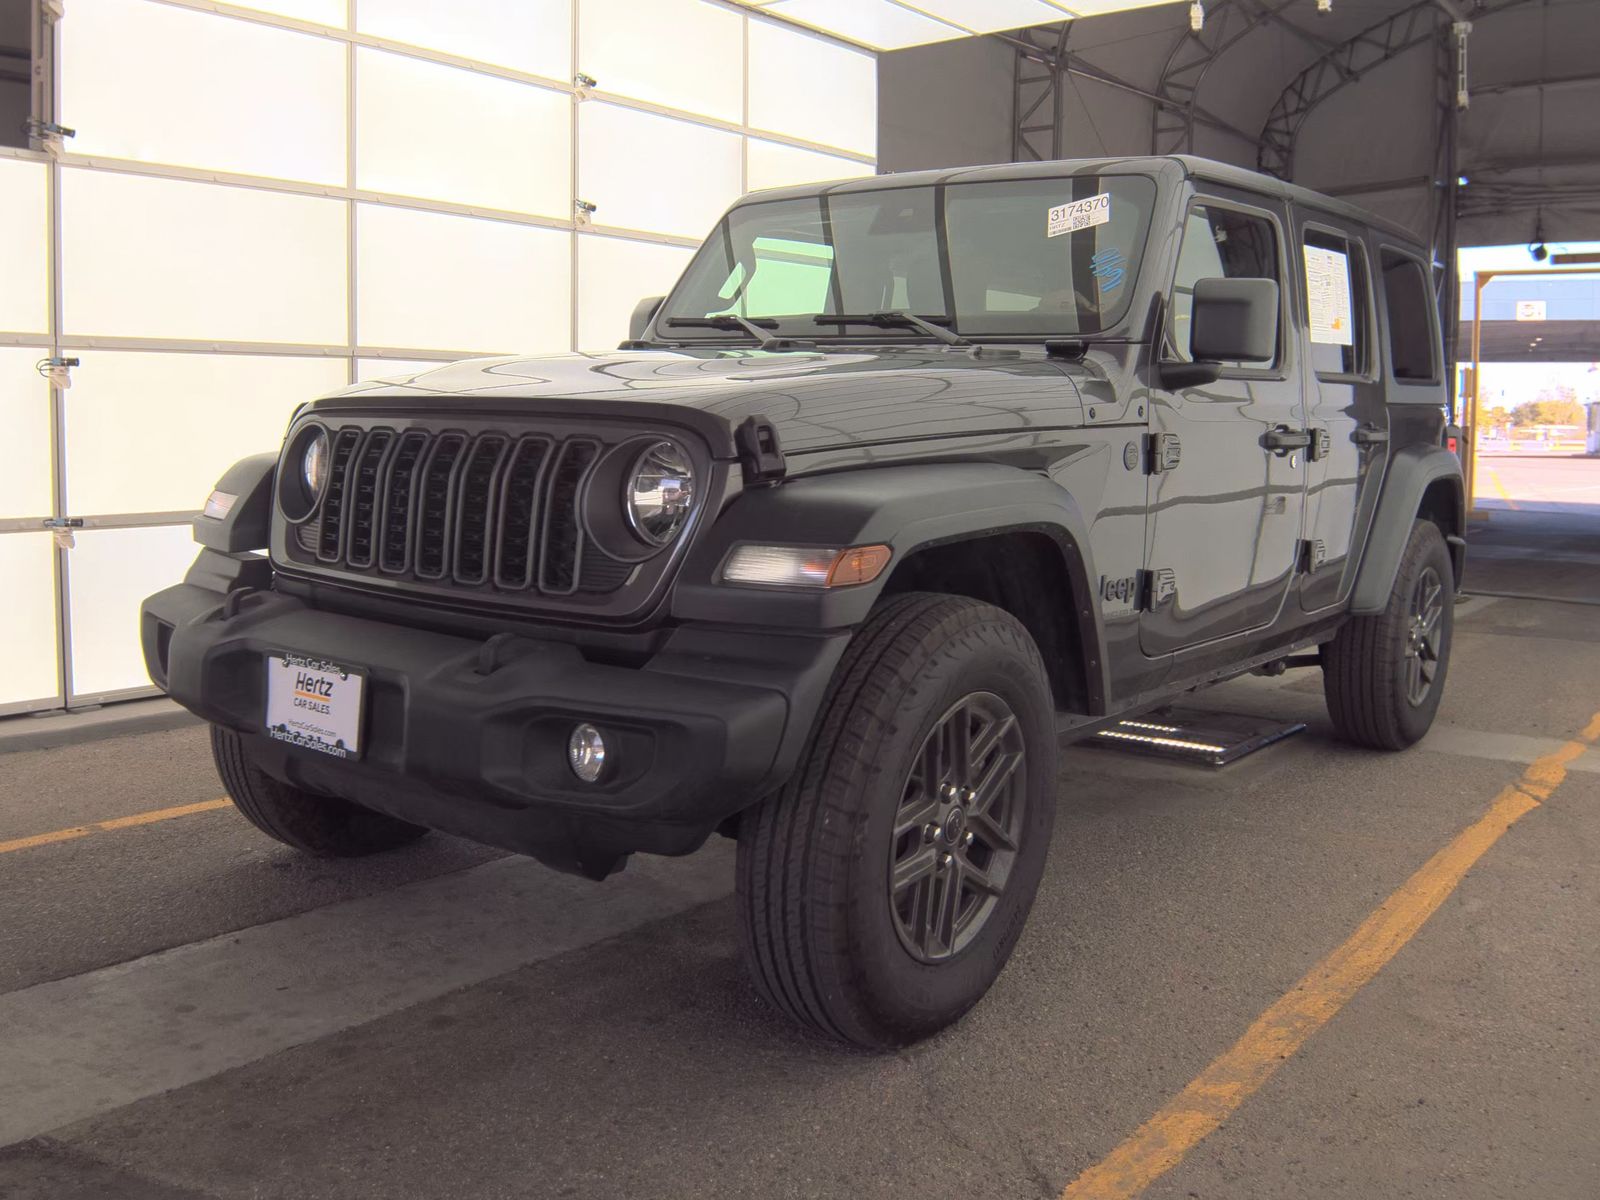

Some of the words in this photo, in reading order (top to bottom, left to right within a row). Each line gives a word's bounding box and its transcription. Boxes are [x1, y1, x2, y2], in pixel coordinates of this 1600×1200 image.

[1051, 196, 1109, 221] 3174370
[1099, 574, 1136, 604] Jeep
[305, 658, 320, 669] Car
[295, 671, 334, 697] Hertz
[293, 697, 308, 709] CAR
[270, 727, 347, 758] HertzCarSales.com
